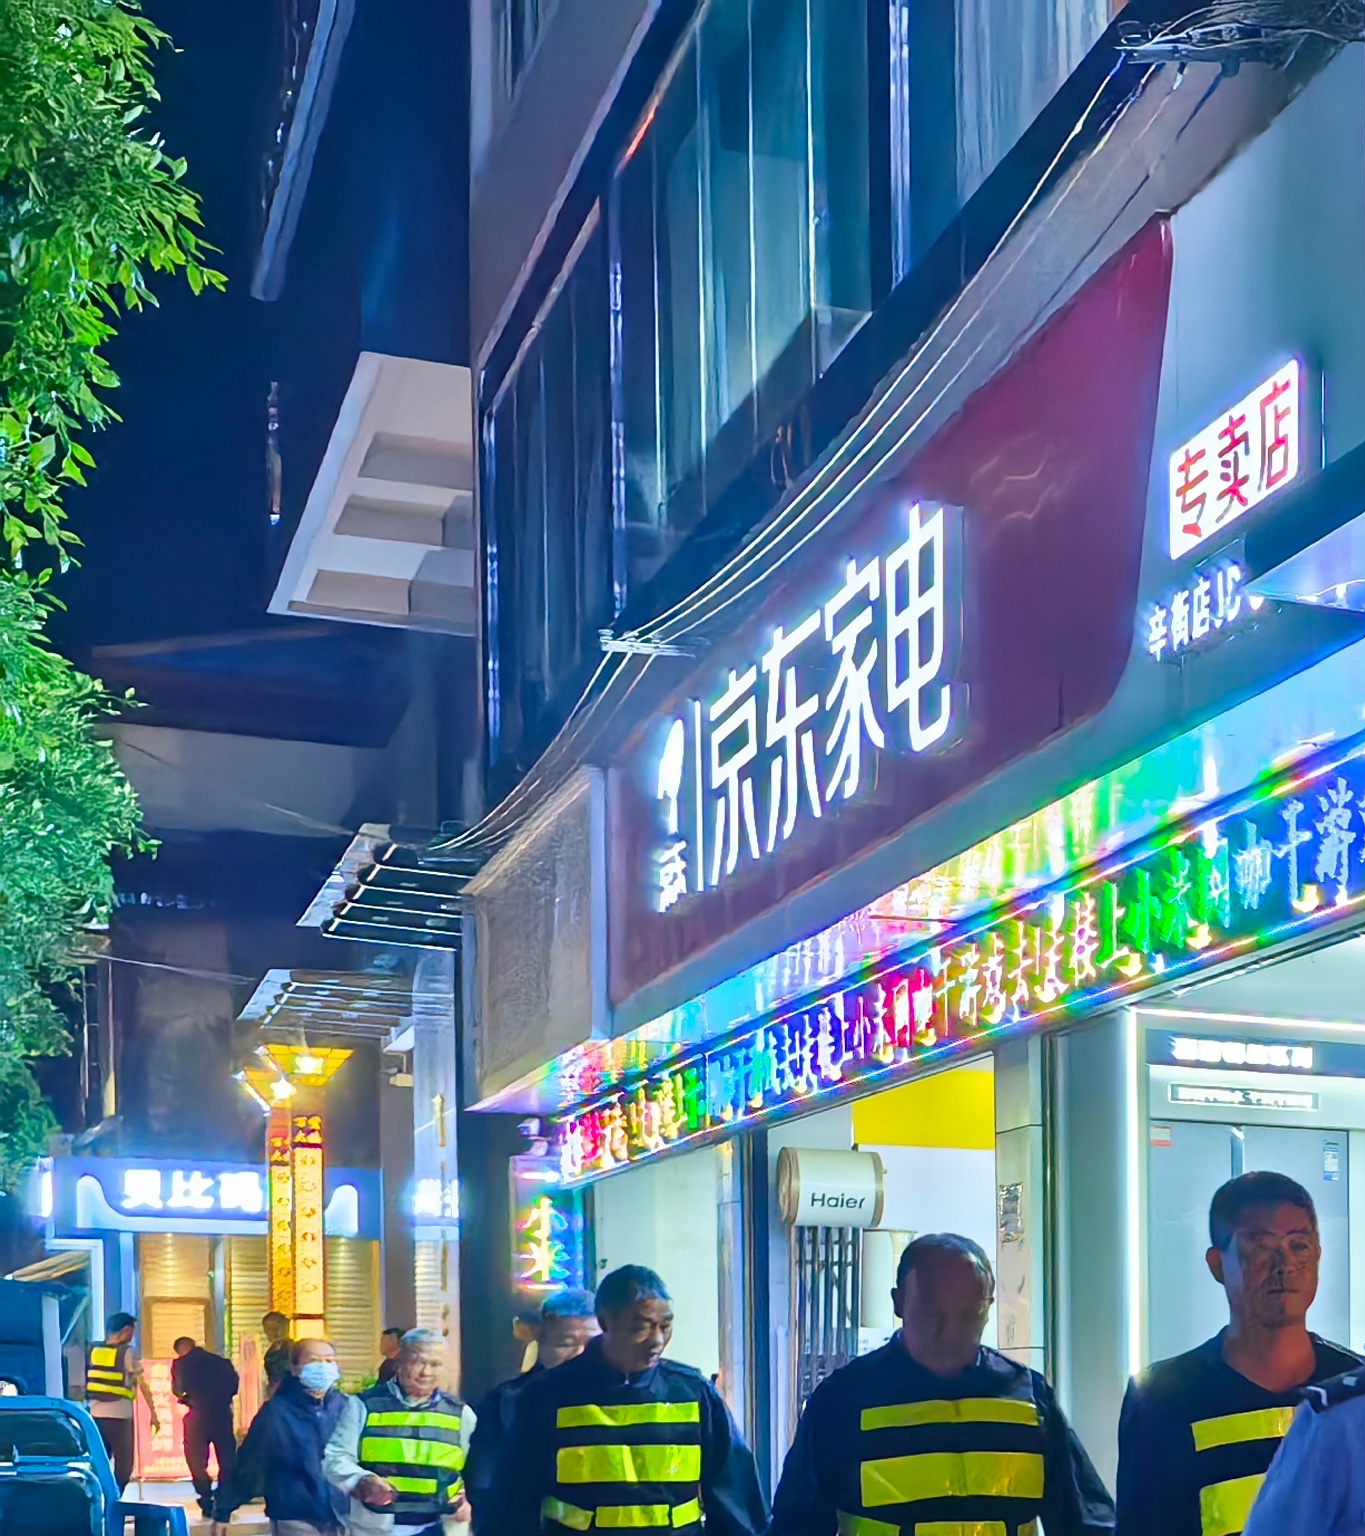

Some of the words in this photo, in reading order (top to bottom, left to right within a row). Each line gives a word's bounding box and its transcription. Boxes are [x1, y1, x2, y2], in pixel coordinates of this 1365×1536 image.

[1175, 379, 1291, 537] 专卖店
[709, 503, 951, 887] 京东家电
[811, 1192, 866, 1209] Haier
